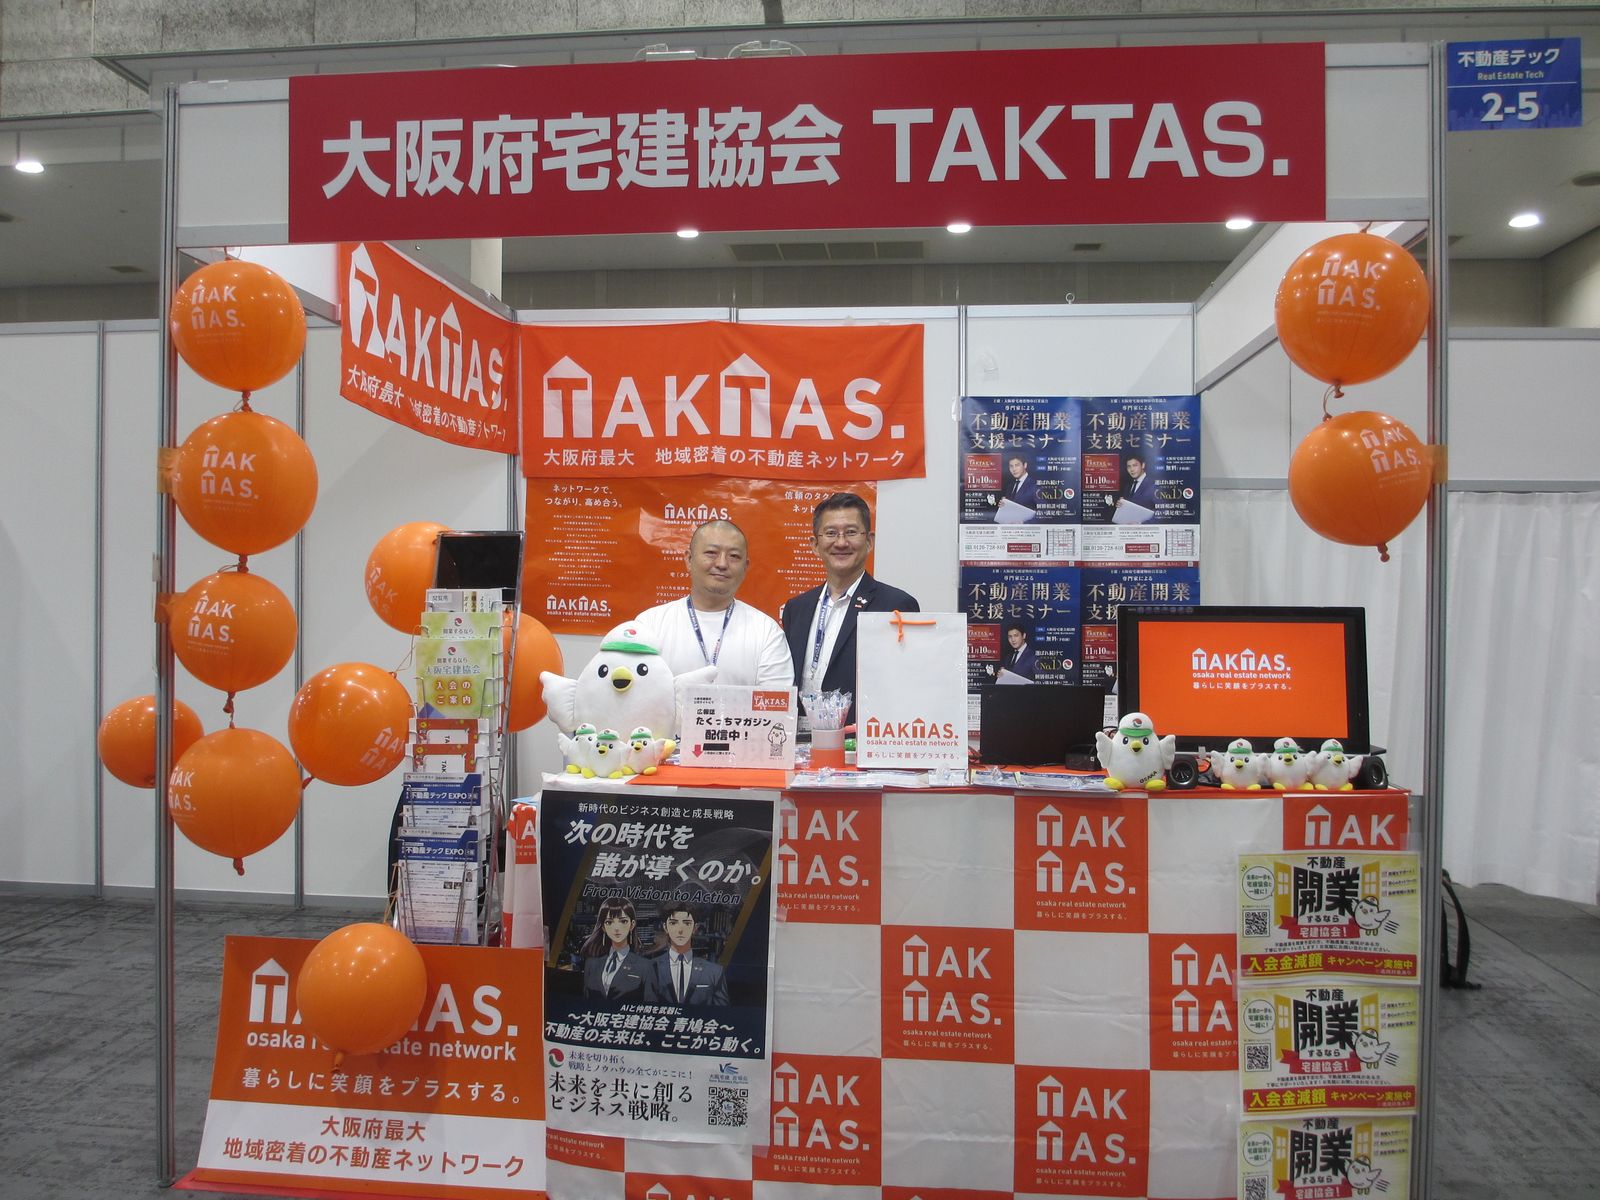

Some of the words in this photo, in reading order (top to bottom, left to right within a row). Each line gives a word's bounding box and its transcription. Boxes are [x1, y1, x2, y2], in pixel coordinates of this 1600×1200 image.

[1457, 48, 1560, 68] 不動産テック
[1478, 72, 1497, 81] Real
[1497, 71, 1524, 80] Estate
[1525, 70, 1544, 79] Tech
[1480, 91, 1540, 122] 2-5
[322, 103, 843, 199] 大阪府宅建協会
[872, 101, 1288, 183] TAKTAS.
[1321, 255, 1381, 280] TAK
[191, 283, 237, 304] TAK
[1317, 278, 1381, 311] TAS.
[191, 306, 246, 330] TAS.
[543, 352, 904, 440] TAKTAS.
[970, 412, 1071, 430] 不動産開業
[1086, 411, 1191, 430] 不動産開業
[970, 433, 1072, 450] 支援セミナー
[1086, 433, 1191, 449] 支援セミナー
[1359, 426, 1408, 450] TAK
[202, 444, 257, 472] TAK
[543, 448, 634, 466] 大阪府最大
[655, 444, 904, 468] 地域密着の不動産ネットワーク
[1369, 448, 1422, 474] TAS.
[200, 469, 260, 500] TAS.
[664, 503, 732, 520] TAKTAS.
[546, 594, 612, 612] TAKTAS.
[968, 582, 1071, 601] 不動産開業
[1086, 582, 1190, 601] 不動産開業
[193, 593, 237, 620] TAK
[968, 603, 1071, 620] 支援セミナー
[187, 614, 235, 644] TAS.
[1192, 647, 1292, 671] TAKTAS.
[436, 680, 471, 690] 入会の
[436, 695, 472, 705] ご案内
[695, 716, 772, 727] たくっちマガジン
[866, 716, 959, 739] TAKTAS.
[704, 729, 749, 741] 配信中！
[578, 802, 734, 820] 新時代のビジネス創造と成長戦略
[564, 819, 694, 850] 次の時代を
[1036, 804, 1126, 848] TAK
[1305, 804, 1395, 846] TAK
[591, 852, 761, 885] 誰が導くのか。
[1036, 850, 1136, 895] TAS.
[1307, 856, 1346, 869] 不動産
[583, 884, 623, 899] From
[626, 886, 673, 901] Vision
[673, 890, 691, 902] to
[692, 892, 741, 905] Action
[1036, 899, 1057, 907] osaka
[1058, 900, 1073, 908] real
[1097, 901, 1126, 909] network
[1293, 865, 1361, 919] 開業
[1306, 915, 1339, 923] するなら
[1299, 926, 1348, 938] 宅建協会！
[902, 934, 992, 979] TAK
[1248, 953, 1323, 971] 入会金減額
[902, 980, 1002, 1025] TAS.
[1305, 988, 1345, 1002] 不動産
[545, 1021, 761, 1054] 不動産の未来は、ここから動く。
[924, 1029, 939, 1037] real
[940, 1030, 962, 1038] estate
[963, 1031, 992, 1039] network
[1292, 998, 1359, 1054] 開業
[247, 1029, 305, 1048] osaka
[429, 1043, 516, 1061] network
[1307, 1049, 1341, 1057] するなら
[568, 1051, 625, 1064] 未来を切り拓く
[1301, 1061, 1350, 1073] 宅建協会！
[242, 1067, 520, 1105] 暮らしに笑顔をプラスする。
[548, 1071, 693, 1103] 未来を共に創る
[773, 1061, 860, 1106] TAK
[551, 1094, 678, 1123] ビジネス戦略。
[1036, 1075, 1128, 1120] TAK
[1250, 1088, 1327, 1107] 入会金減額
[320, 1115, 427, 1142] 大阪府最大
[773, 1106, 870, 1151] TAS.
[1302, 1117, 1339, 1131] 不動産
[578, 1139, 605, 1149] network
[1036, 1120, 1136, 1165] TAS.
[222, 1136, 524, 1177] 地域密着の不動産ネットワーク
[794, 1154, 809, 1162] real
[809, 1155, 831, 1163] estate
[831, 1156, 860, 1164] network
[1290, 1126, 1353, 1184] 開業
[1301, 1176, 1333, 1184] するなら
